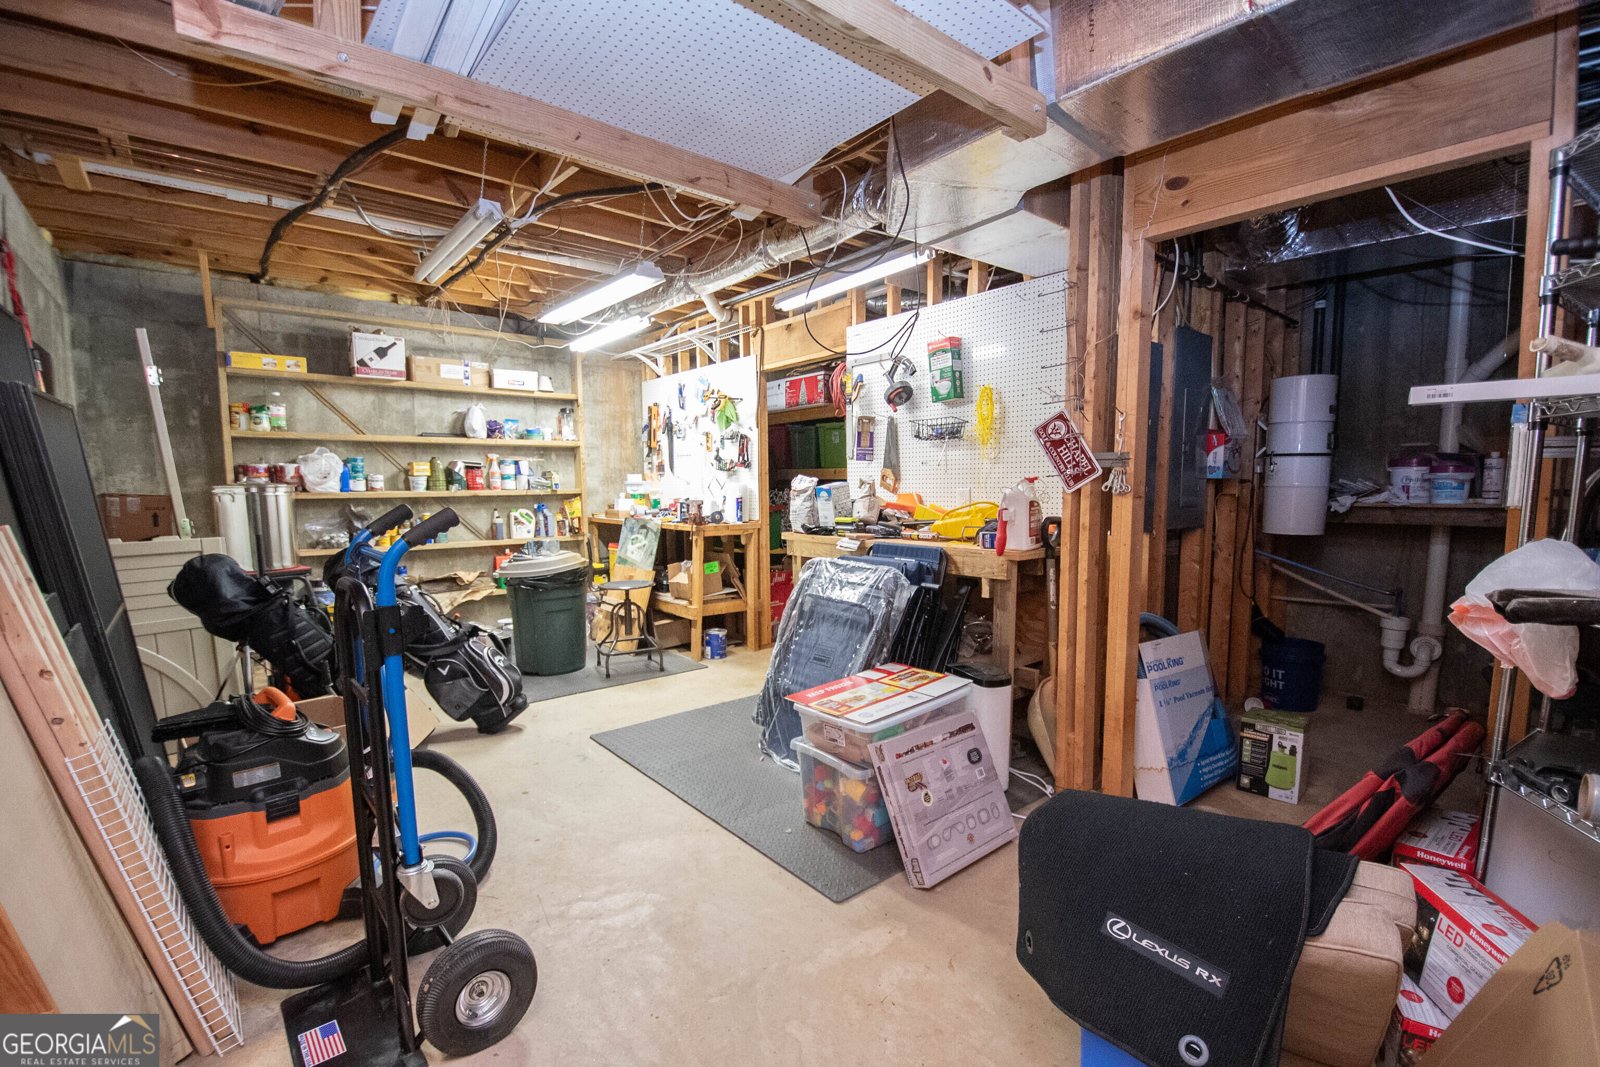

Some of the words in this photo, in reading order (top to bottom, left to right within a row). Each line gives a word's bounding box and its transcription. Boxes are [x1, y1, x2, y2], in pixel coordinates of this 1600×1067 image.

[1048, 446, 1066, 472] COUNTRY
[1063, 434, 1092, 475] CHAPEL
[1416, 850, 1466, 870] Honeywell
[1437, 918, 1464, 948] LED
[1132, 933, 1190, 970] LEXUS
[1196, 966, 1222, 988] RX
